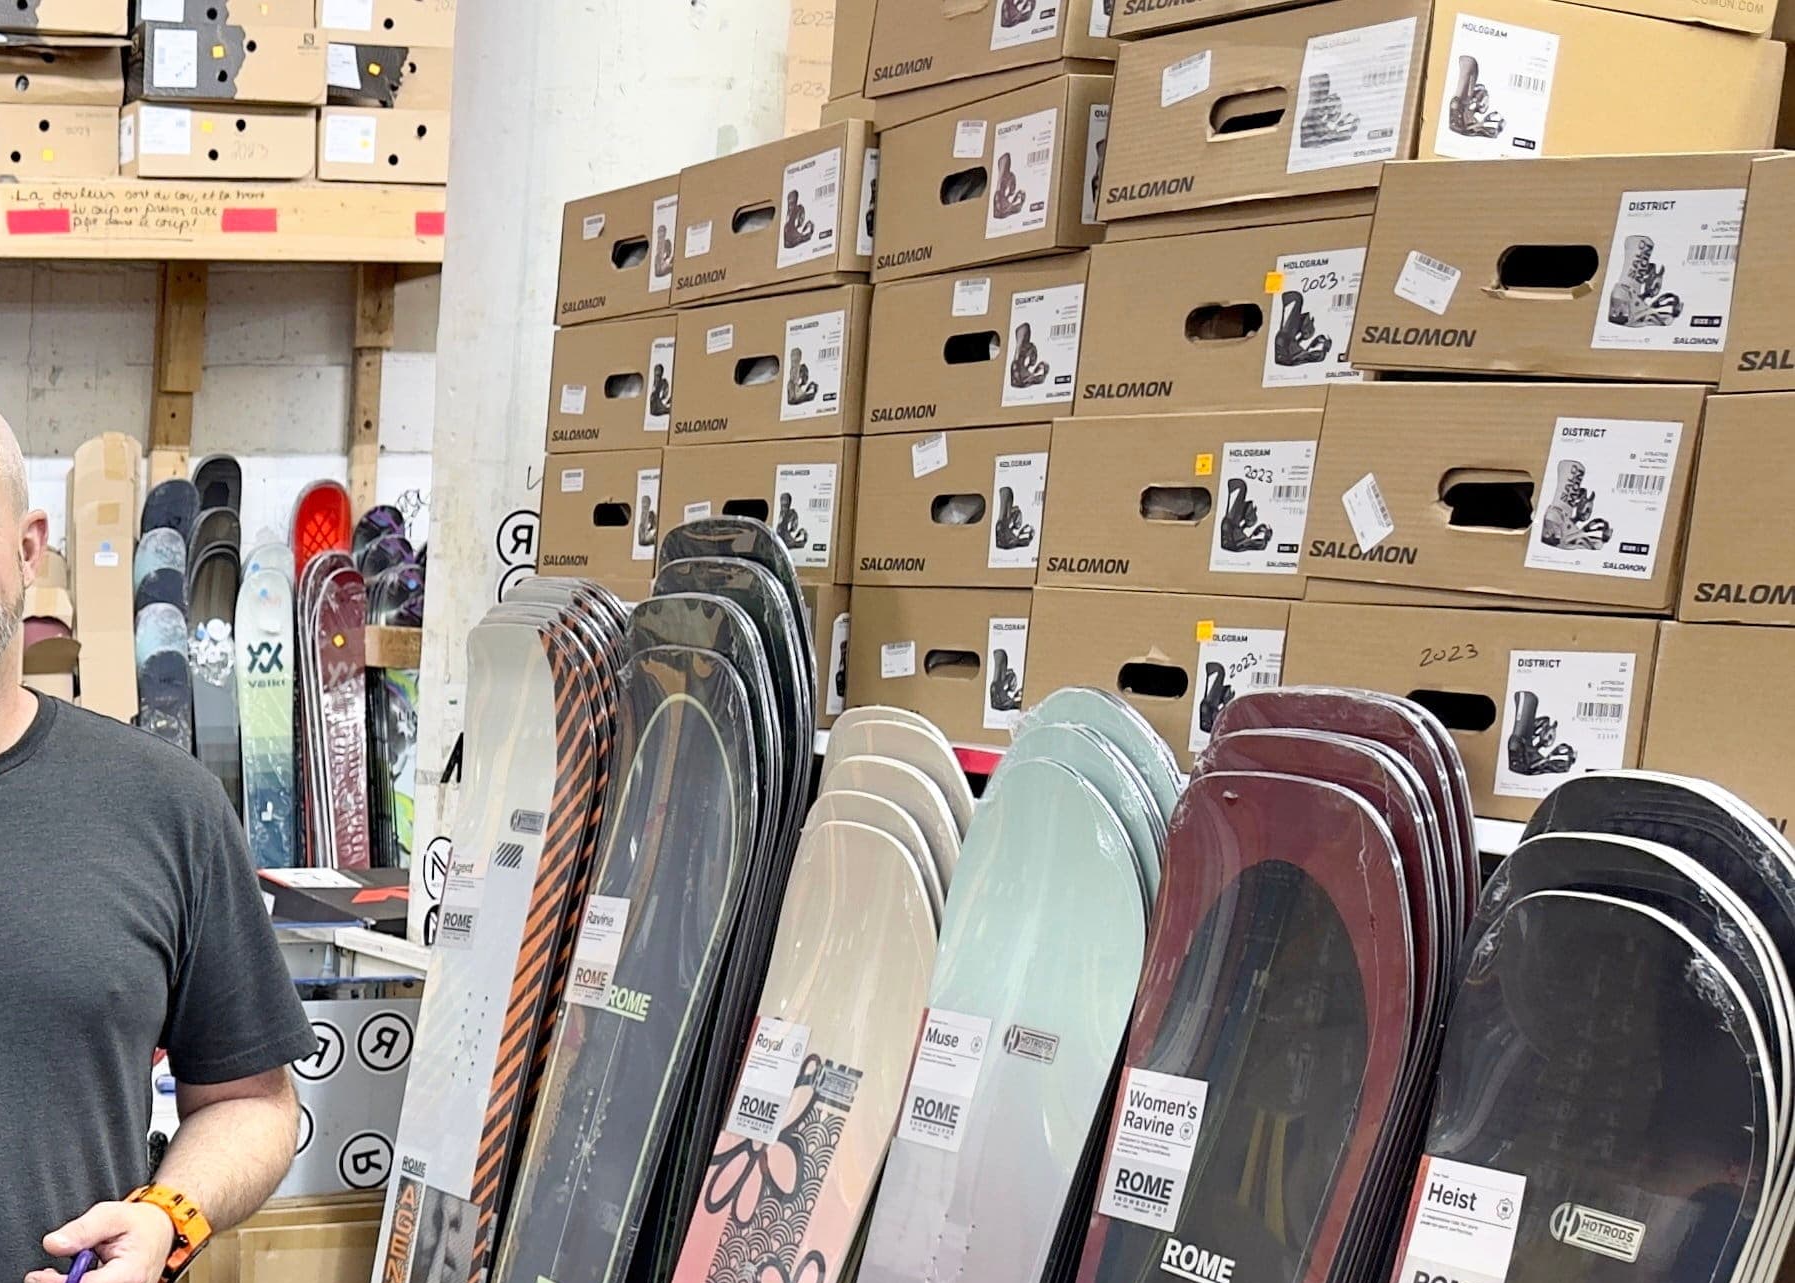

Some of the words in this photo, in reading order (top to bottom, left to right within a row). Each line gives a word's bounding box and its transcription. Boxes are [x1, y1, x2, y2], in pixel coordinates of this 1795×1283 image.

[1462, 22, 1508, 39] HOLOGRAM
[873, 57, 933, 82] SALOMON
[1107, 176, 1194, 203] SALOMON
[1628, 200, 1676, 211] DISTRICT
[877, 247, 933, 270] SALOMON
[1284, 259, 1329, 269] HOLOGRAM
[677, 269, 727, 290] SALOMON
[1301, 272, 1338, 293] 2023
[562, 296, 606, 314] SALOMON
[1361, 326, 1477, 348] SALOMON
[1672, 336, 1720, 345] SALOMON
[1084, 381, 1173, 400] SALOMON
[872, 404, 936, 421] SALOMON
[552, 428, 599, 442] SALOMON
[675, 418, 728, 434] SALOMON
[1562, 427, 1607, 439] DISTRICT
[1229, 449, 1271, 457] HOLOGRAM
[1244, 465, 1273, 484] 2023
[543, 554, 588, 566] SALOMON
[1308, 539, 1418, 565] SALOMON
[860, 557, 925, 571] SALOMON
[1046, 557, 1130, 575] SALOMON
[1602, 561, 1647, 573] SALOMON
[1212, 634, 1248, 643] OLOGRAM
[1229, 653, 1258, 678] 2023
[1418, 644, 1479, 667] 2023
[1517, 658, 1562, 668] DISTRICT
[443, 912, 473, 930] ROME
[586, 910, 615, 929] Ravine
[575, 967, 609, 988] ROME
[608, 985, 652, 1016] ROME
[755, 1032, 784, 1053] Royal
[926, 1026, 960, 1048] Muse
[740, 1095, 780, 1121] ROME
[912, 1097, 961, 1124] ROME
[1129, 1089, 1198, 1120] Women's
[1123, 1110, 1175, 1137] Ravine
[402, 1156, 426, 1177] ROME
[1115, 1168, 1175, 1201] ROME
[1428, 1182, 1478, 1212] Heist
[1581, 1219, 1636, 1244] HOTRODS
